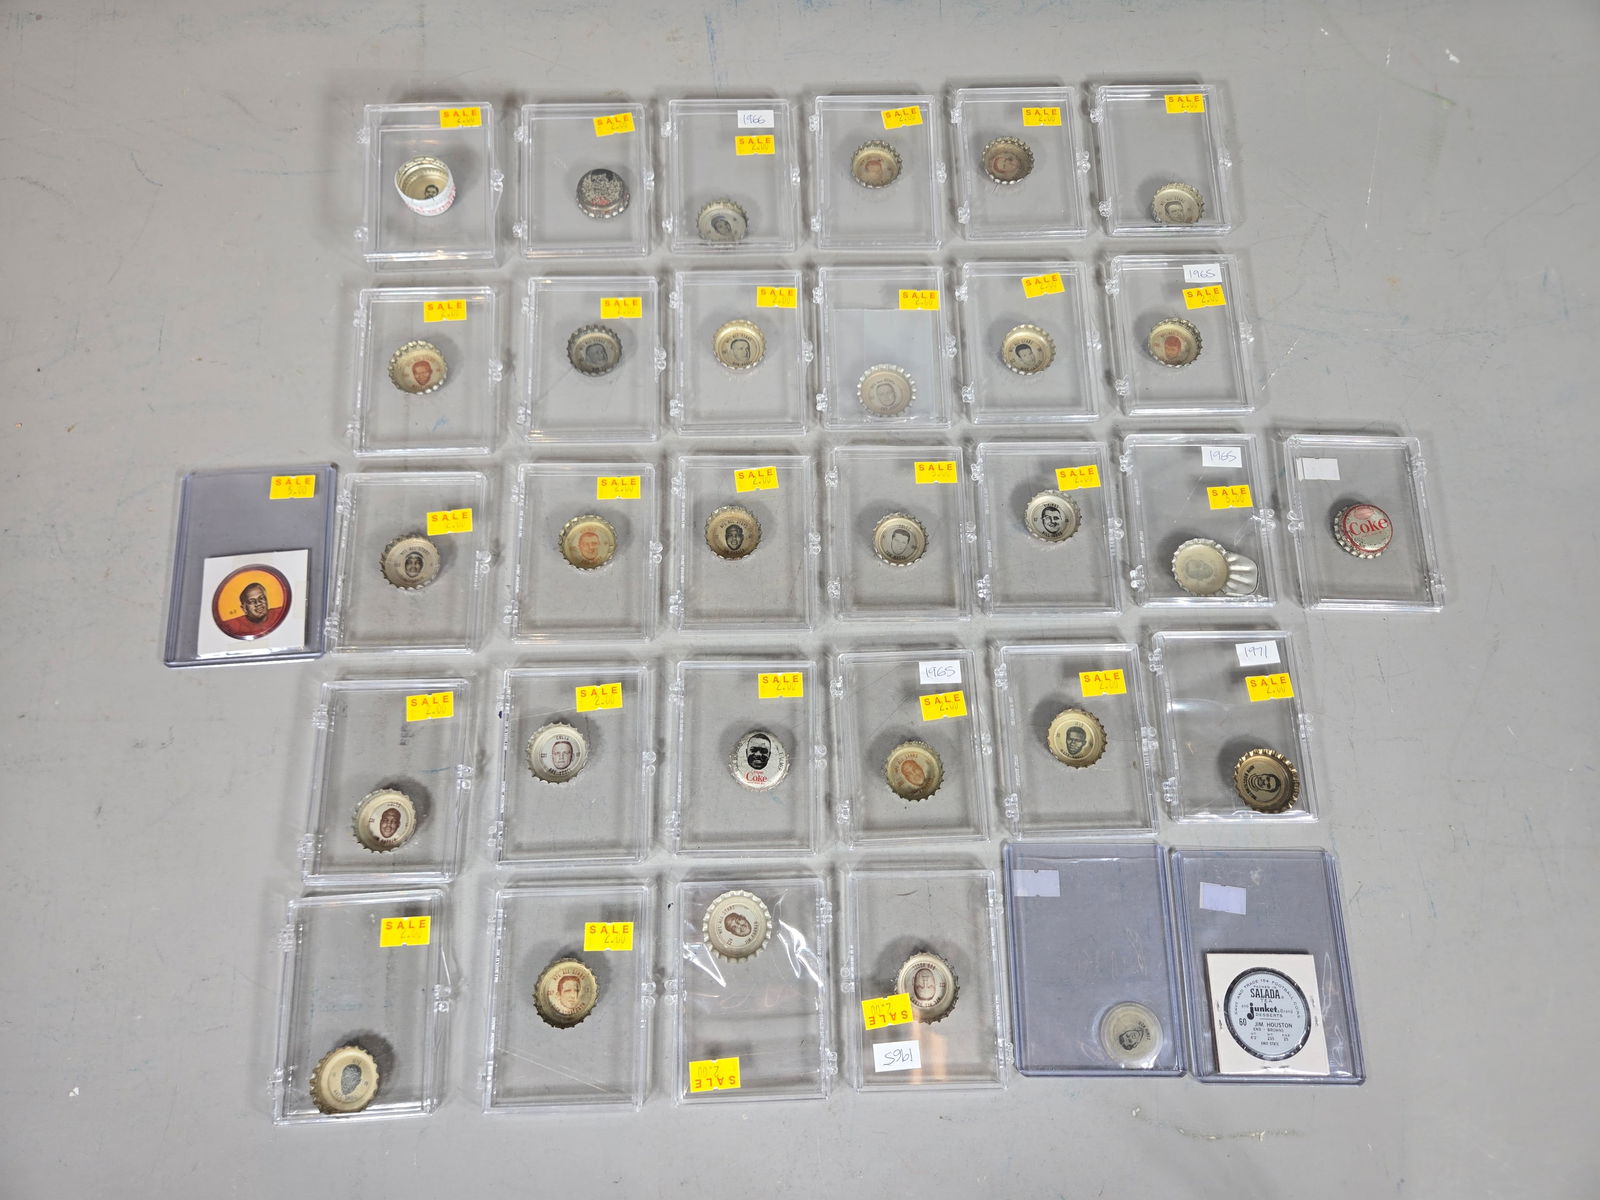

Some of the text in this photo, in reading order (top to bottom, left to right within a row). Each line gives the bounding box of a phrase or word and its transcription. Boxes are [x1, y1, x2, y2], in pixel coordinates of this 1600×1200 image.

[886, 108, 916, 118] SALE
[598, 115, 629, 125] SALE
[1190, 270, 1216, 278] 1965
[1026, 276, 1057, 286] SALE
[1188, 288, 1219, 297] SALE
[1210, 450, 1236, 462] 1965
[739, 469, 772, 479] SALE
[1061, 468, 1094, 478] SALE
[1212, 488, 1246, 496] SALE
[432, 512, 467, 522] SALE
[1349, 518, 1388, 536] Coke
[1244, 646, 1268, 658] 1971
[926, 666, 956, 677] 1965
[1084, 673, 1120, 682] SALE
[1251, 677, 1286, 687] SALE
[581, 687, 617, 697] SALE
[411, 695, 448, 706] SALE
[924, 694, 960, 705] SALE
[746, 772, 768, 782] Coke
[386, 920, 425, 930] SALE
[1250, 988, 1280, 999] SALADA
[1247, 1002, 1278, 1020] junket
[869, 1011, 908, 1025] SALE
[883, 1048, 912, 1066] 1965
[696, 1076, 735, 1088] SALE
